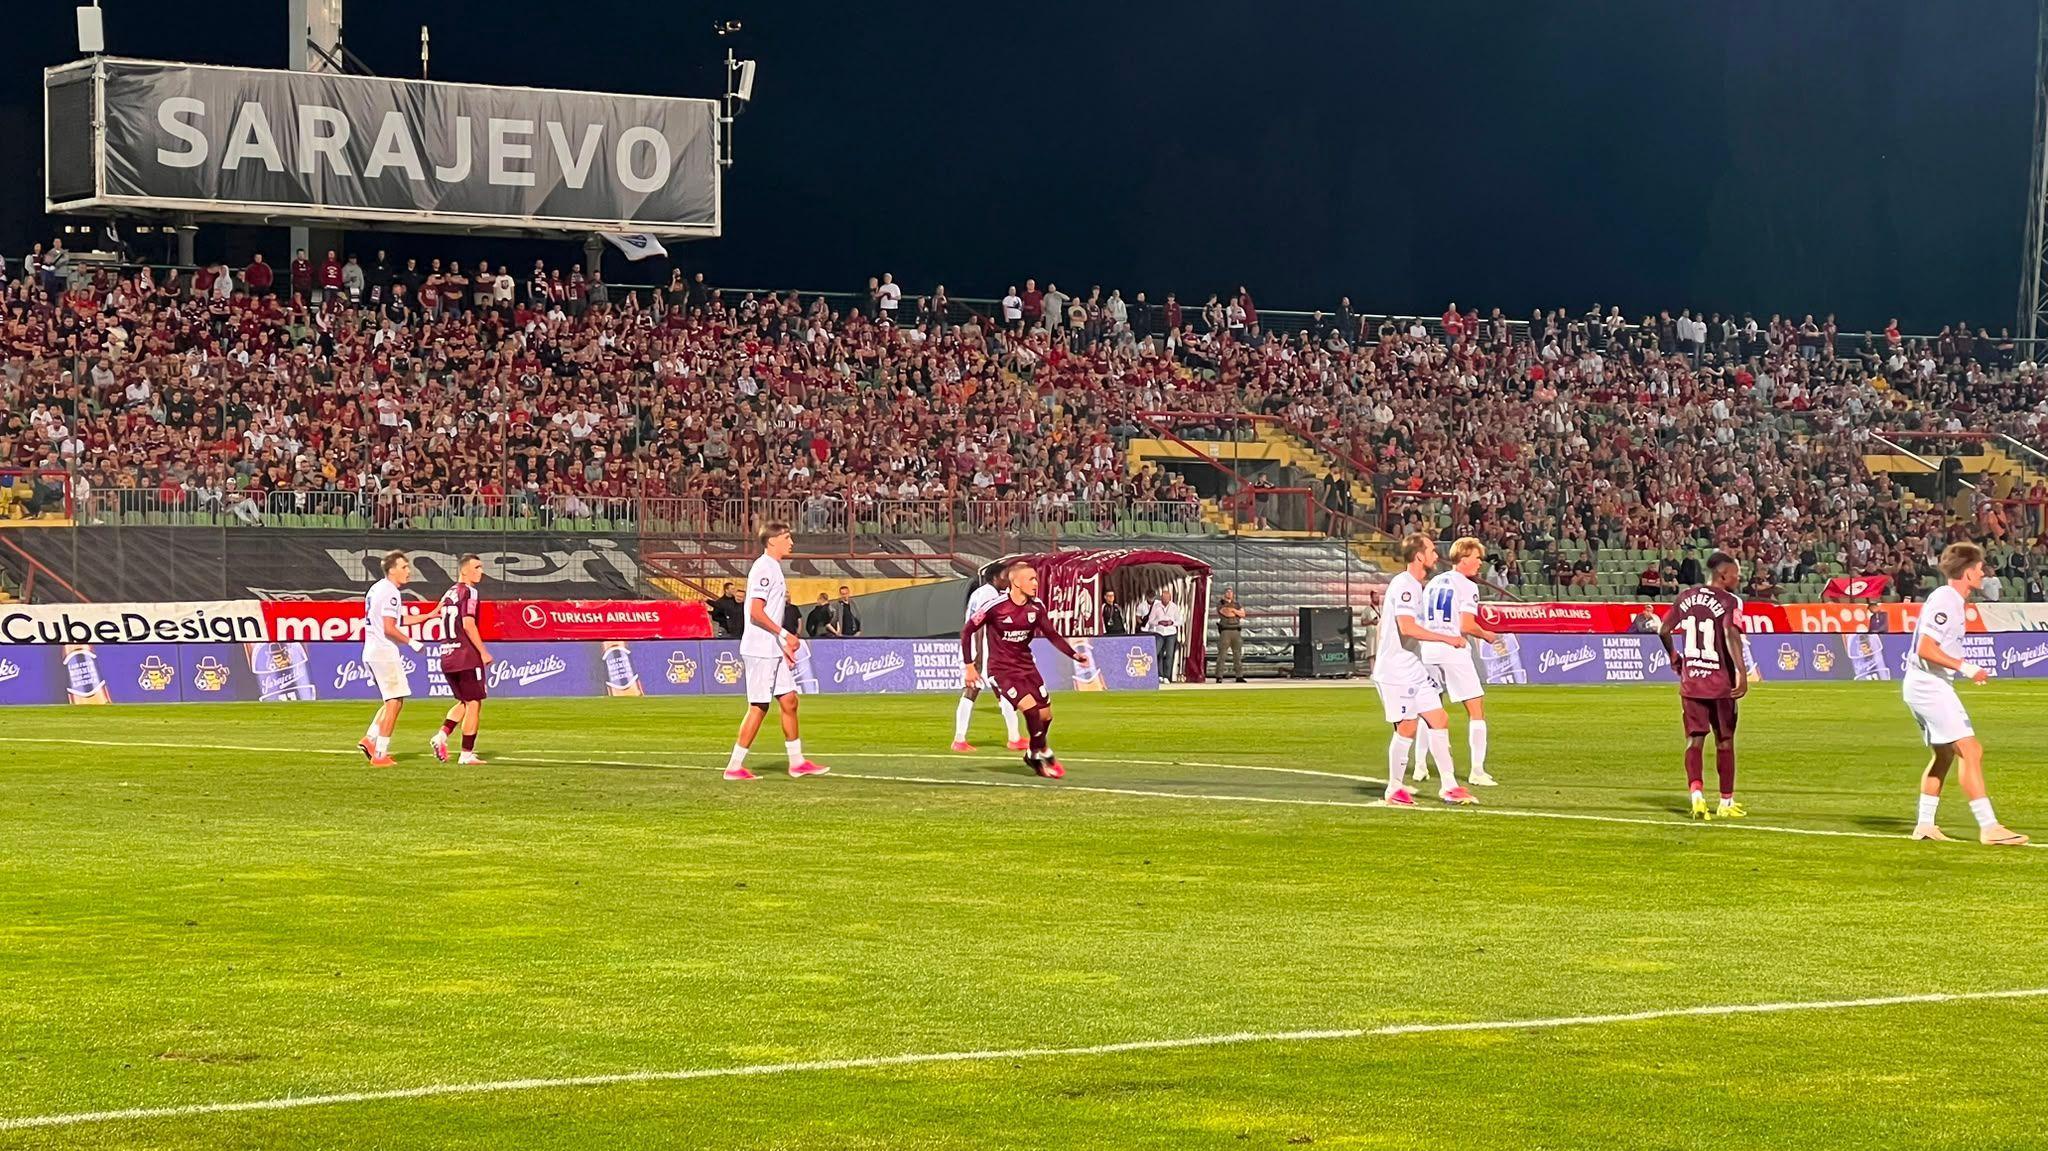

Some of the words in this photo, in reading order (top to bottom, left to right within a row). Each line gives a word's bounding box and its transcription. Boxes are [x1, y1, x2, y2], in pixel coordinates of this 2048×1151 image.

[156, 96, 672, 192] SARAJEVO
[1428, 588, 1454, 622] 14
[550, 611, 602, 624] TURKISH
[606, 611, 660, 623] AIRLINES
[1502, 607, 1547, 619] TURKISH
[1549, 608, 1591, 620] AIRLINES
[1, 610, 262, 643] CubeDesign
[1607, 638, 1619, 646] AM
[1620, 638, 1640, 646] FROM
[1681, 615, 1719, 662] 11
[912, 643, 917, 653] I
[918, 643, 932, 653] AM
[933, 643, 959, 653] FROM
[914, 655, 960, 667] BOSNIA
[1538, 645, 1597, 673] Sarajevsko
[487, 654, 566, 688] Sarajevsko
[833, 651, 905, 683] Sarajevsko
[915, 669, 936, 677] TAKE
[937, 669, 949, 677] ME
[428, 674, 448, 683] TAK
[1606, 670, 1644, 679] AMERICA
[917, 679, 962, 689] AMERICA
